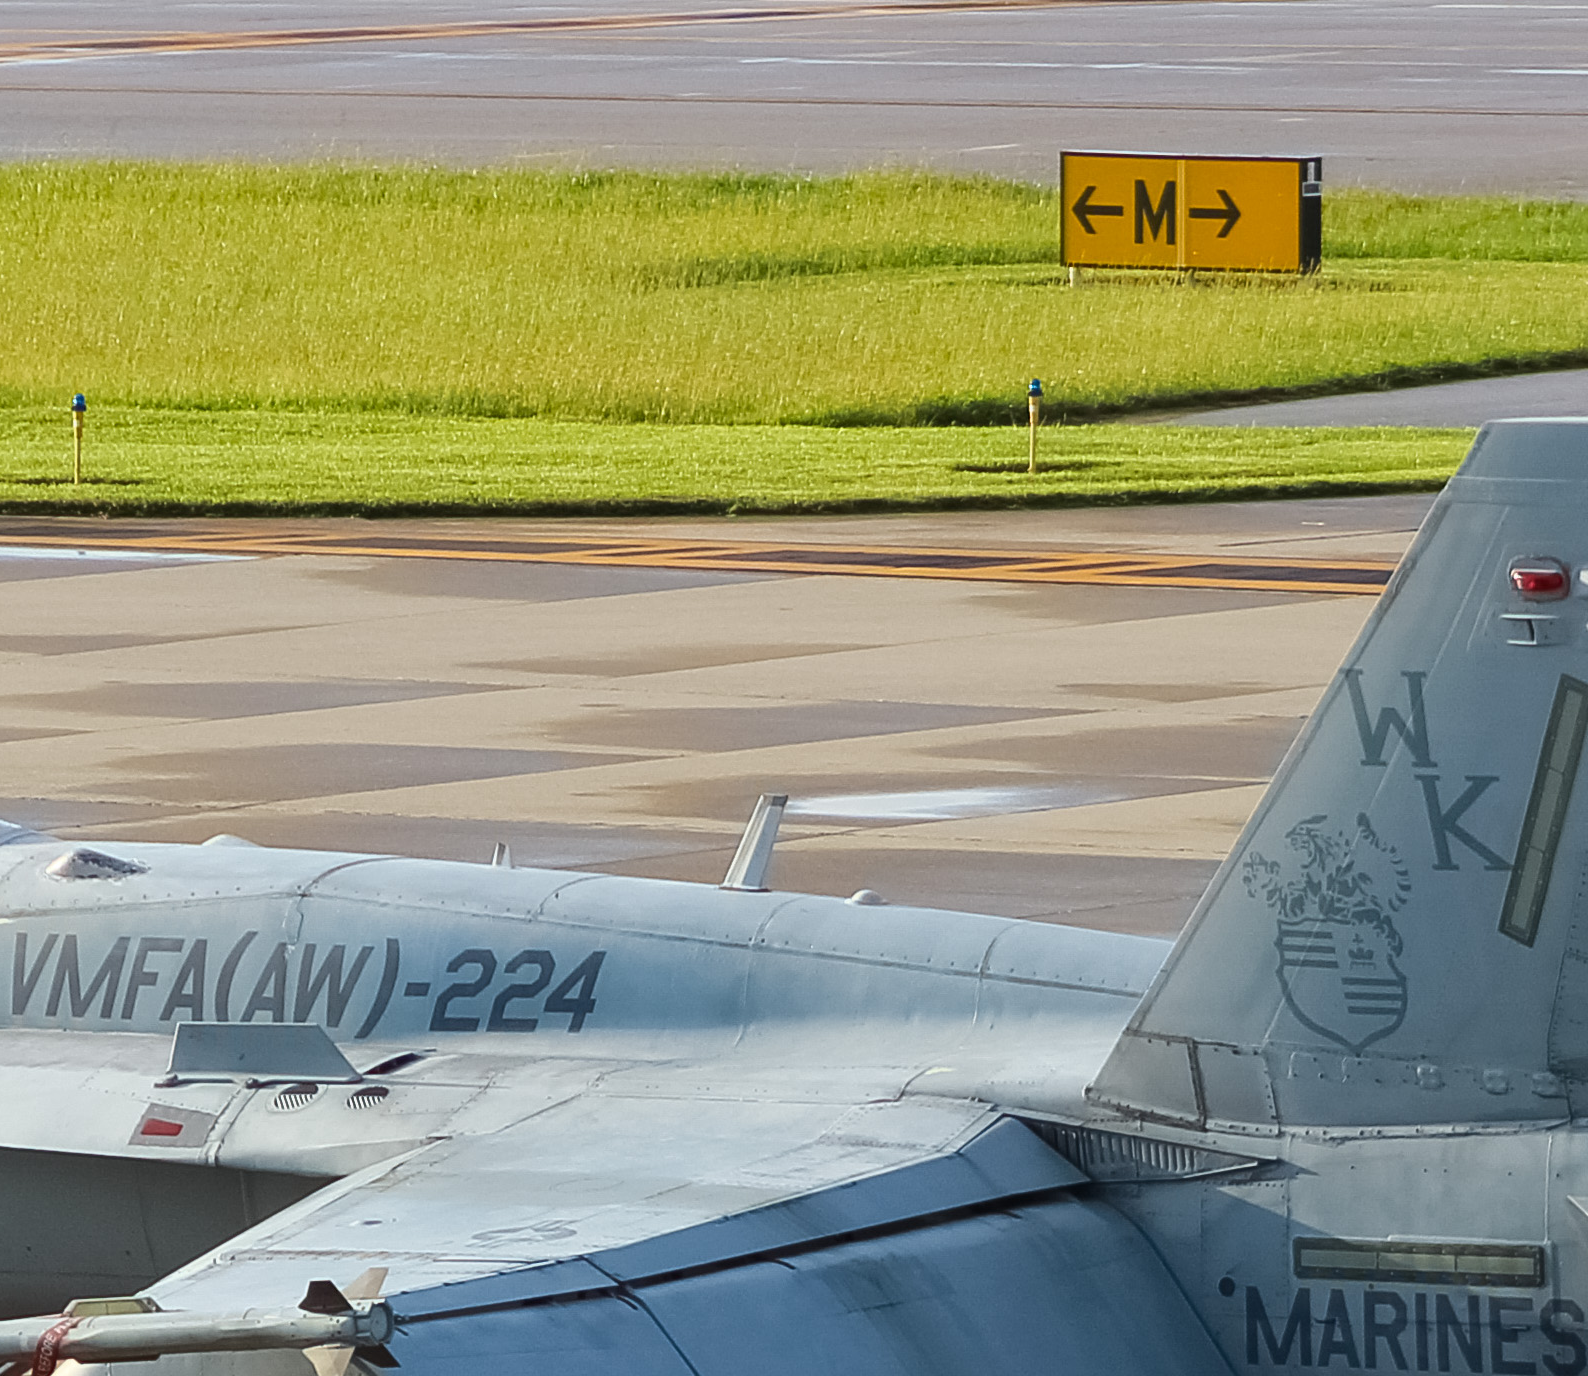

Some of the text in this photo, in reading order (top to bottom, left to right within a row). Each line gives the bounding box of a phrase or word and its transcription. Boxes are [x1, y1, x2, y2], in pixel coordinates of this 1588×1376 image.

[1134, 180, 1176, 245] M
[1340, 668, 1439, 767] W
[1415, 775, 1515, 872] K
[13, 930, 607, 1040] VMFA(AW)-224
